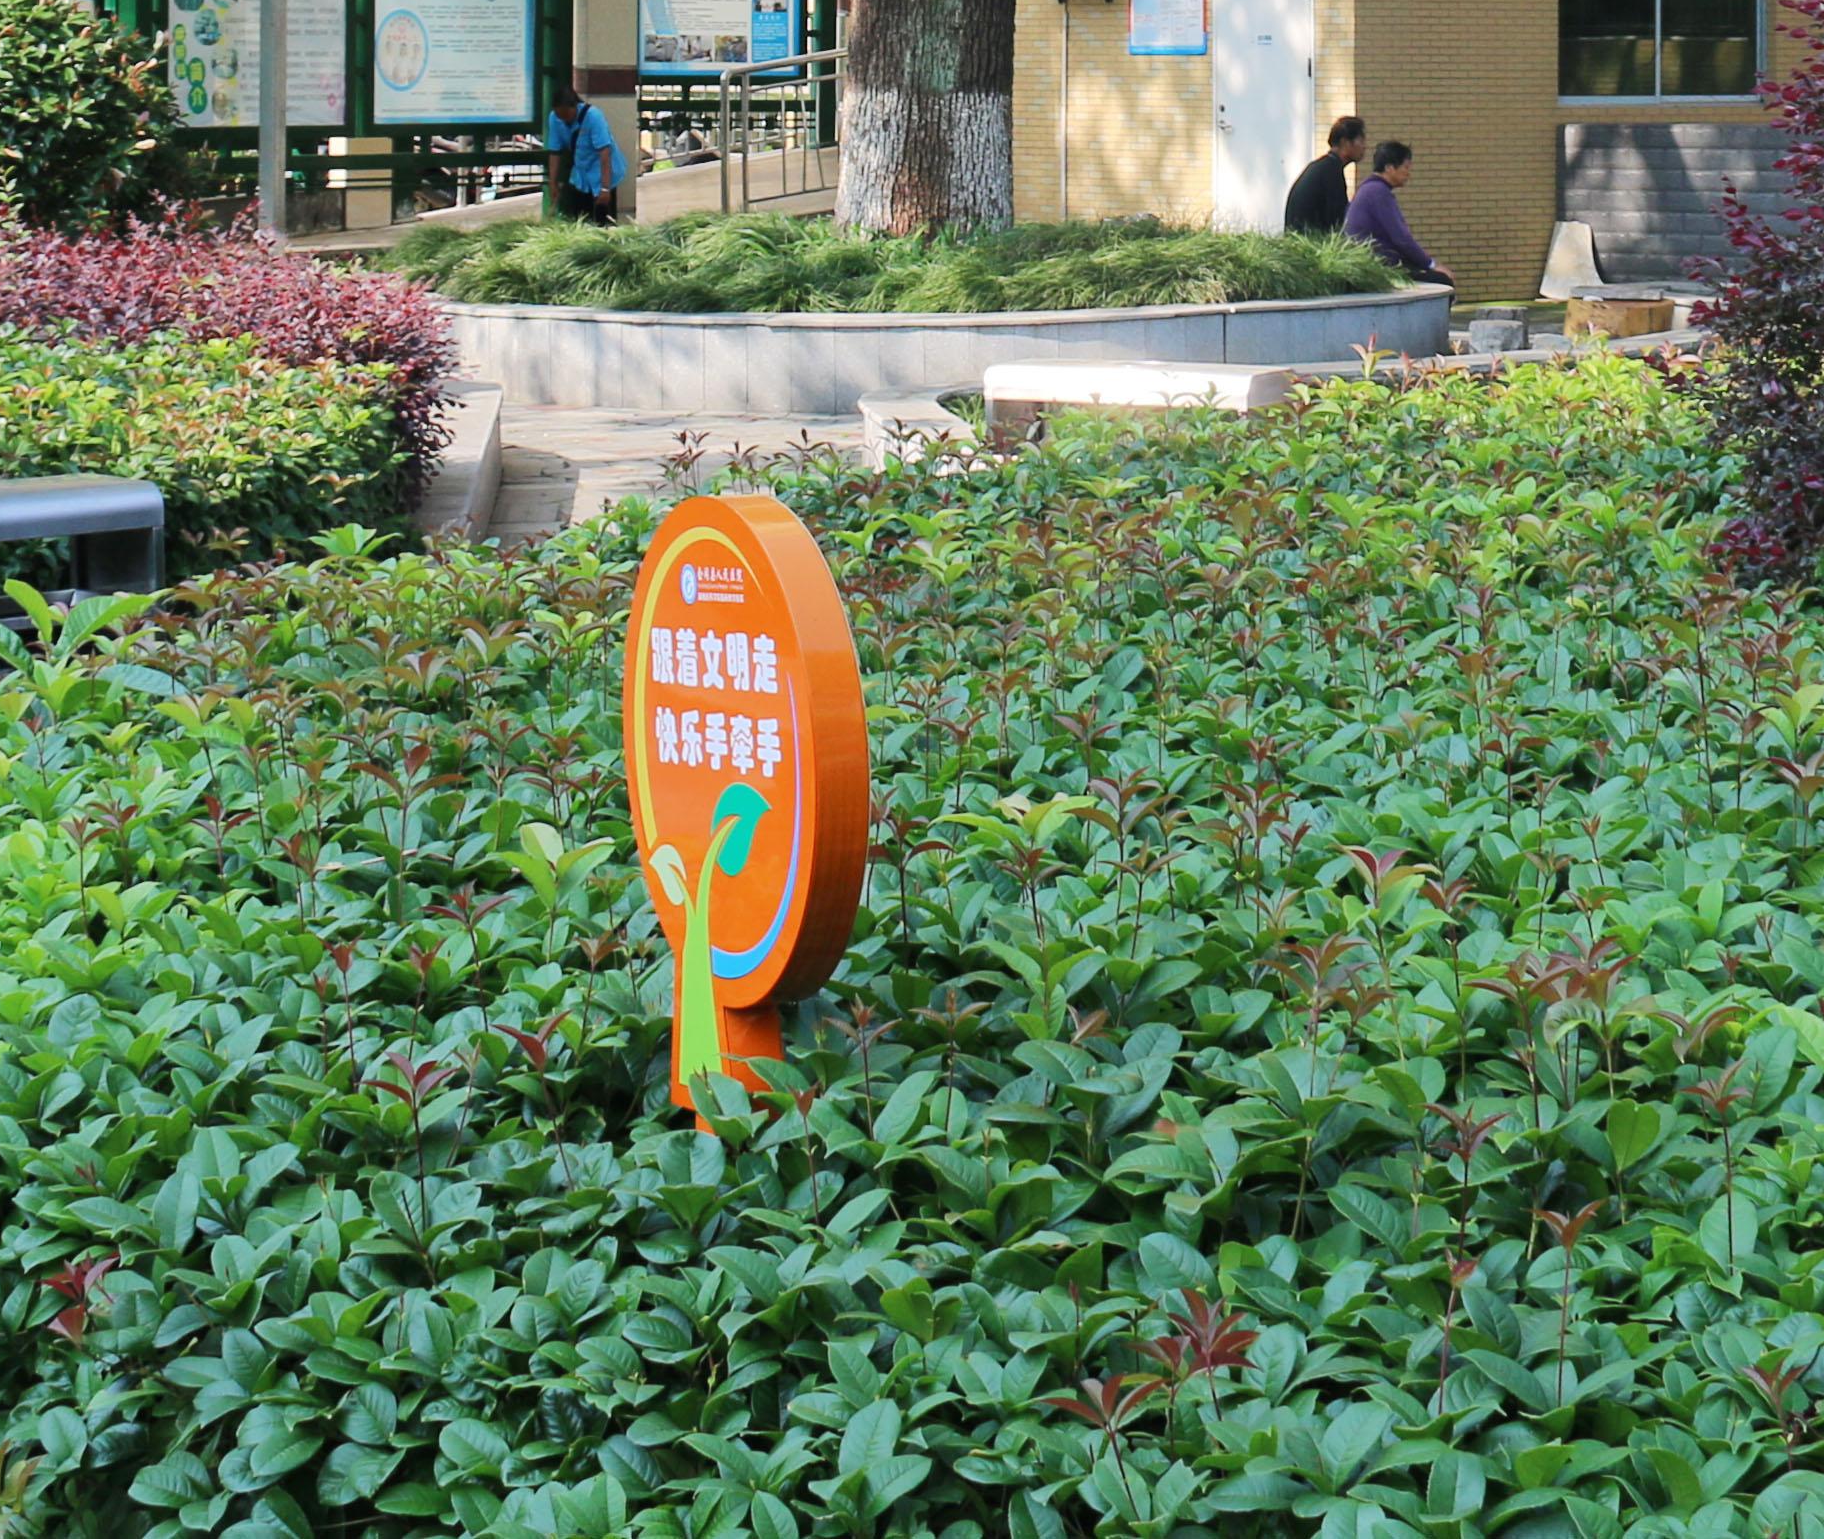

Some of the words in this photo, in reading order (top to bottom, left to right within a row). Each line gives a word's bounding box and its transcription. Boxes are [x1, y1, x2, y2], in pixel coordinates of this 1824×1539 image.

[651, 626, 779, 694] 跟着文明走
[655, 705, 783, 778] 快乐手牵手
